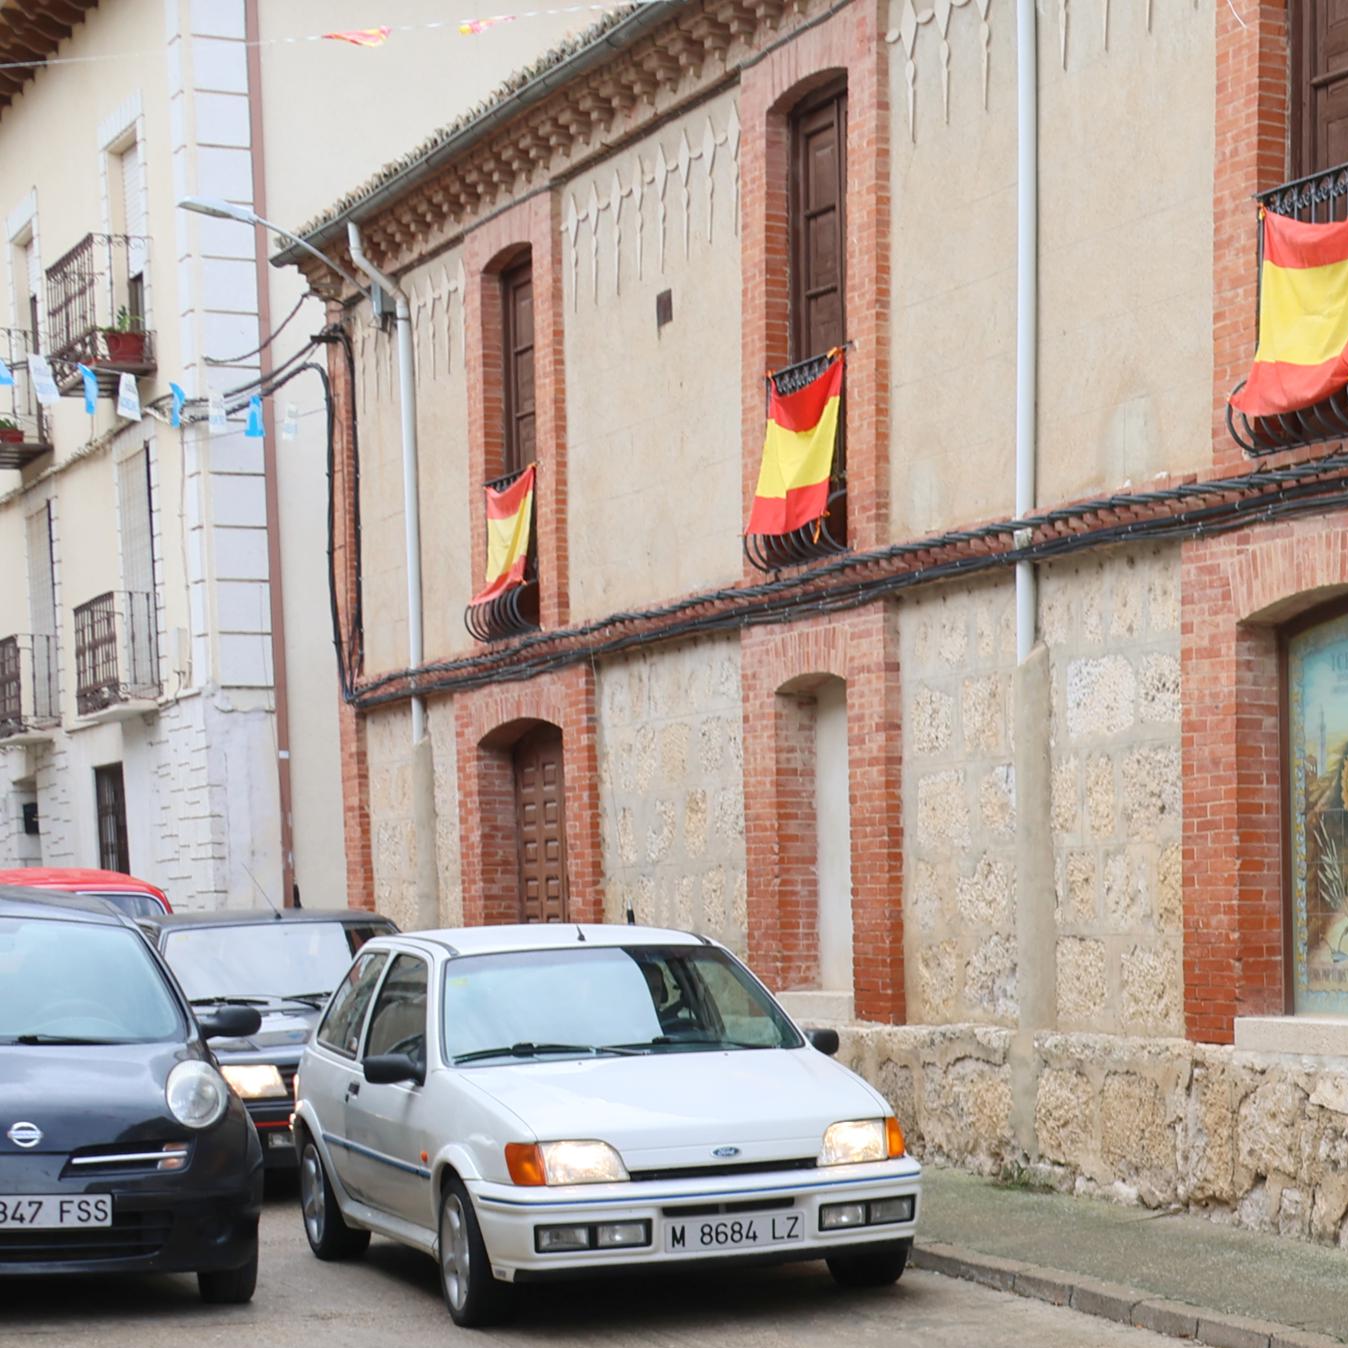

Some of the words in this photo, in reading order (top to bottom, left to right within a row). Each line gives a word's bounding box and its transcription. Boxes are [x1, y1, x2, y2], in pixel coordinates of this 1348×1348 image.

[59, 1200, 108, 1223] FSS
[671, 1225, 686, 1248] M
[700, 1220, 759, 1246] 8684
[772, 1215, 799, 1240] LZ
